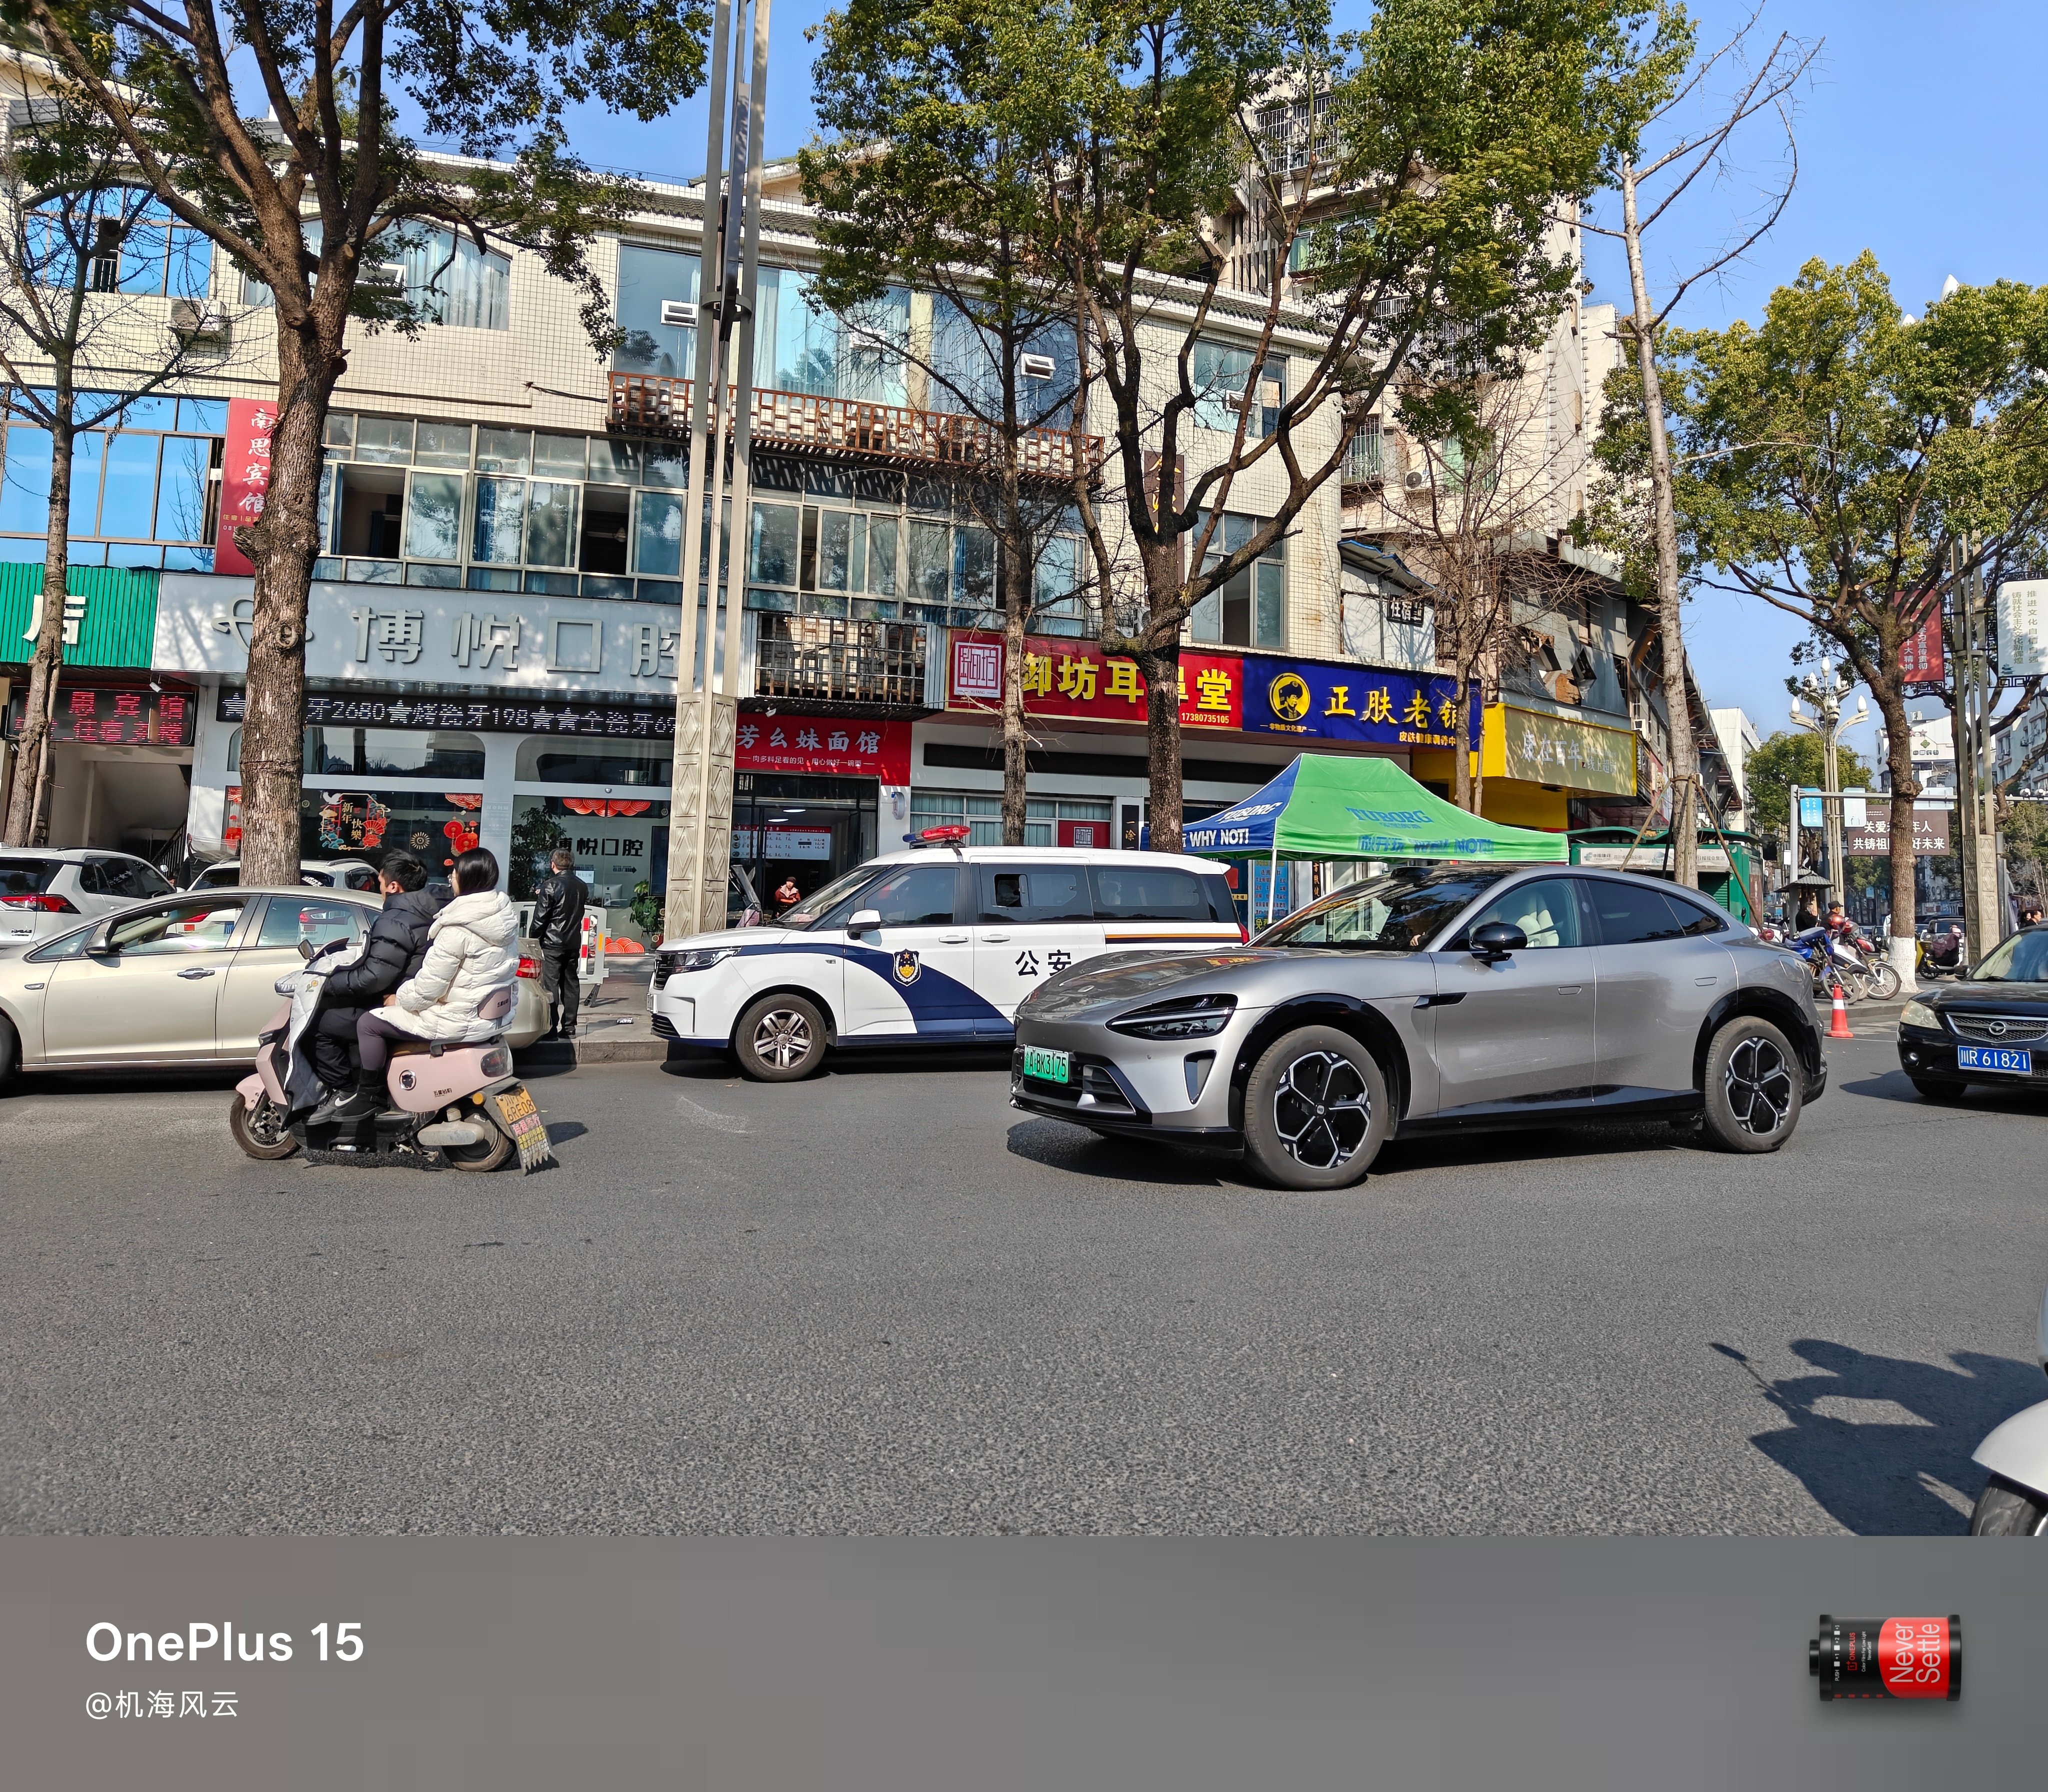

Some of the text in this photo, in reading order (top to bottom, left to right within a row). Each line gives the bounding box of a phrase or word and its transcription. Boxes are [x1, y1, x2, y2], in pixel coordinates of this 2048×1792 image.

[239, 408, 278, 514] 南思宾馆
[2012, 592, 2024, 664] 铸就社会主义文化新辉煌
[2026, 590, 2038, 664] 推进文化自信自强
[352, 606, 696, 678] 博悦口腔
[1023, 652, 1232, 711] 御坊耳堂
[1182, 712, 1230, 724] 17380735105
[1269, 723, 1307, 733] 非物质文化遗产
[736, 724, 880, 754] 芳幺妹面馆
[1587, 755, 1616, 774] 线上超市
[342, 802, 354, 824] 新年
[1344, 806, 1434, 824] TUBORG
[351, 818, 363, 840] 快樂
[1864, 820, 1932, 833] 关爱年人
[1190, 830, 1217, 848] WHY
[1220, 828, 1249, 845] NOT!
[1853, 837, 1945, 850] 共铸祖好未来
[1015, 948, 1072, 977] 公安
